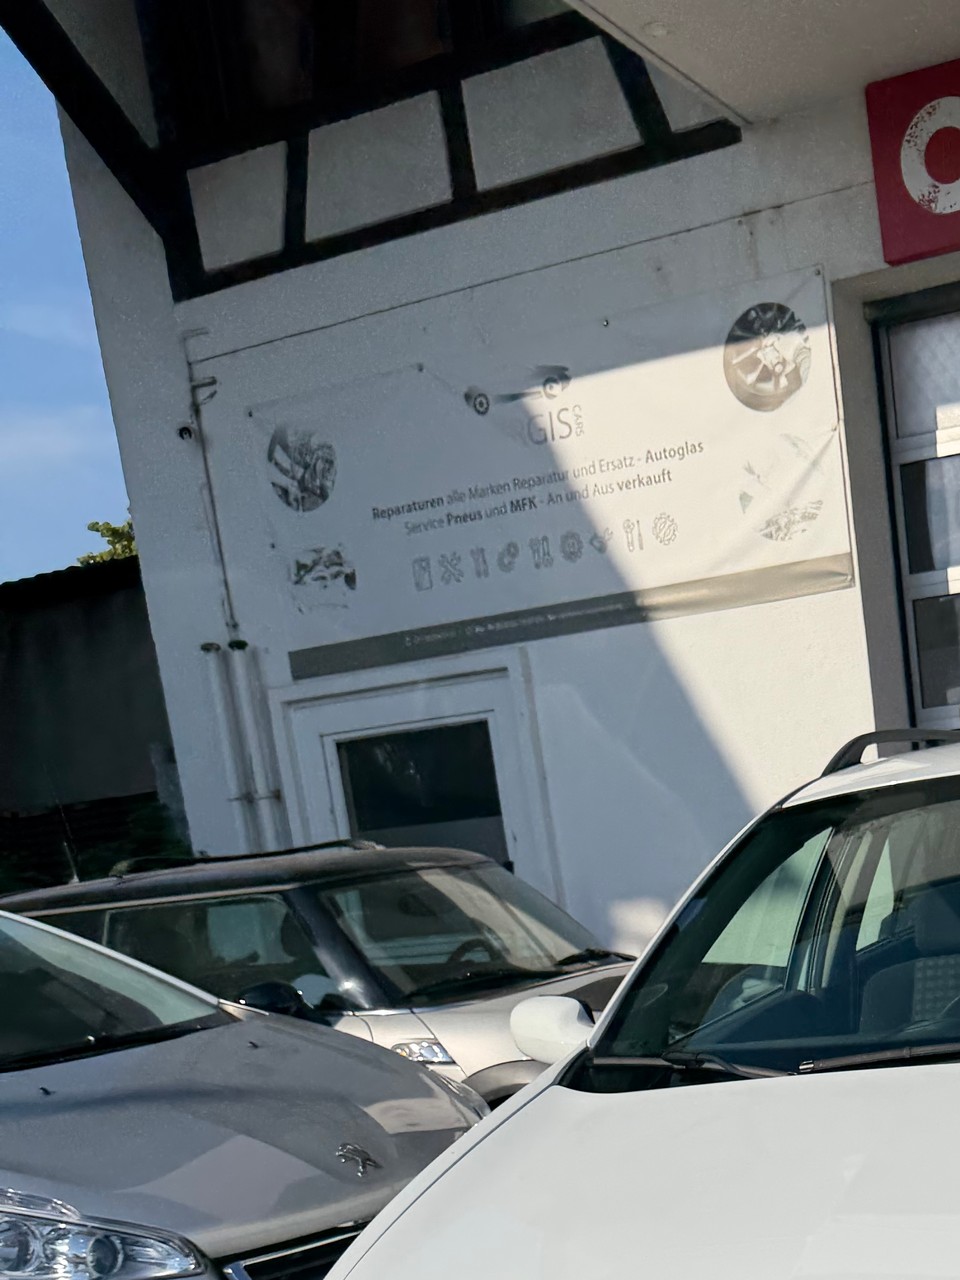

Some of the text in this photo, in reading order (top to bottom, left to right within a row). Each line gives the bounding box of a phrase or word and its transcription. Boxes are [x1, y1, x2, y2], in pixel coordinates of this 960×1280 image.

[371, 495, 445, 521] Reparaturen
[468, 481, 511, 501] Marken
[512, 470, 570, 491] Reparatur
[573, 462, 596, 478] und
[599, 454, 635, 474] Ersatz
[645, 441, 704, 464] Autoglas
[404, 516, 445, 536] Service
[446, 508, 483, 527] Pneus
[485, 502, 508, 519] und
[510, 495, 538, 514] MFK
[547, 492, 563, 506] An
[565, 484, 590, 501] und
[592, 482, 615, 498] Aus
[616, 468, 673, 492] verkauft
